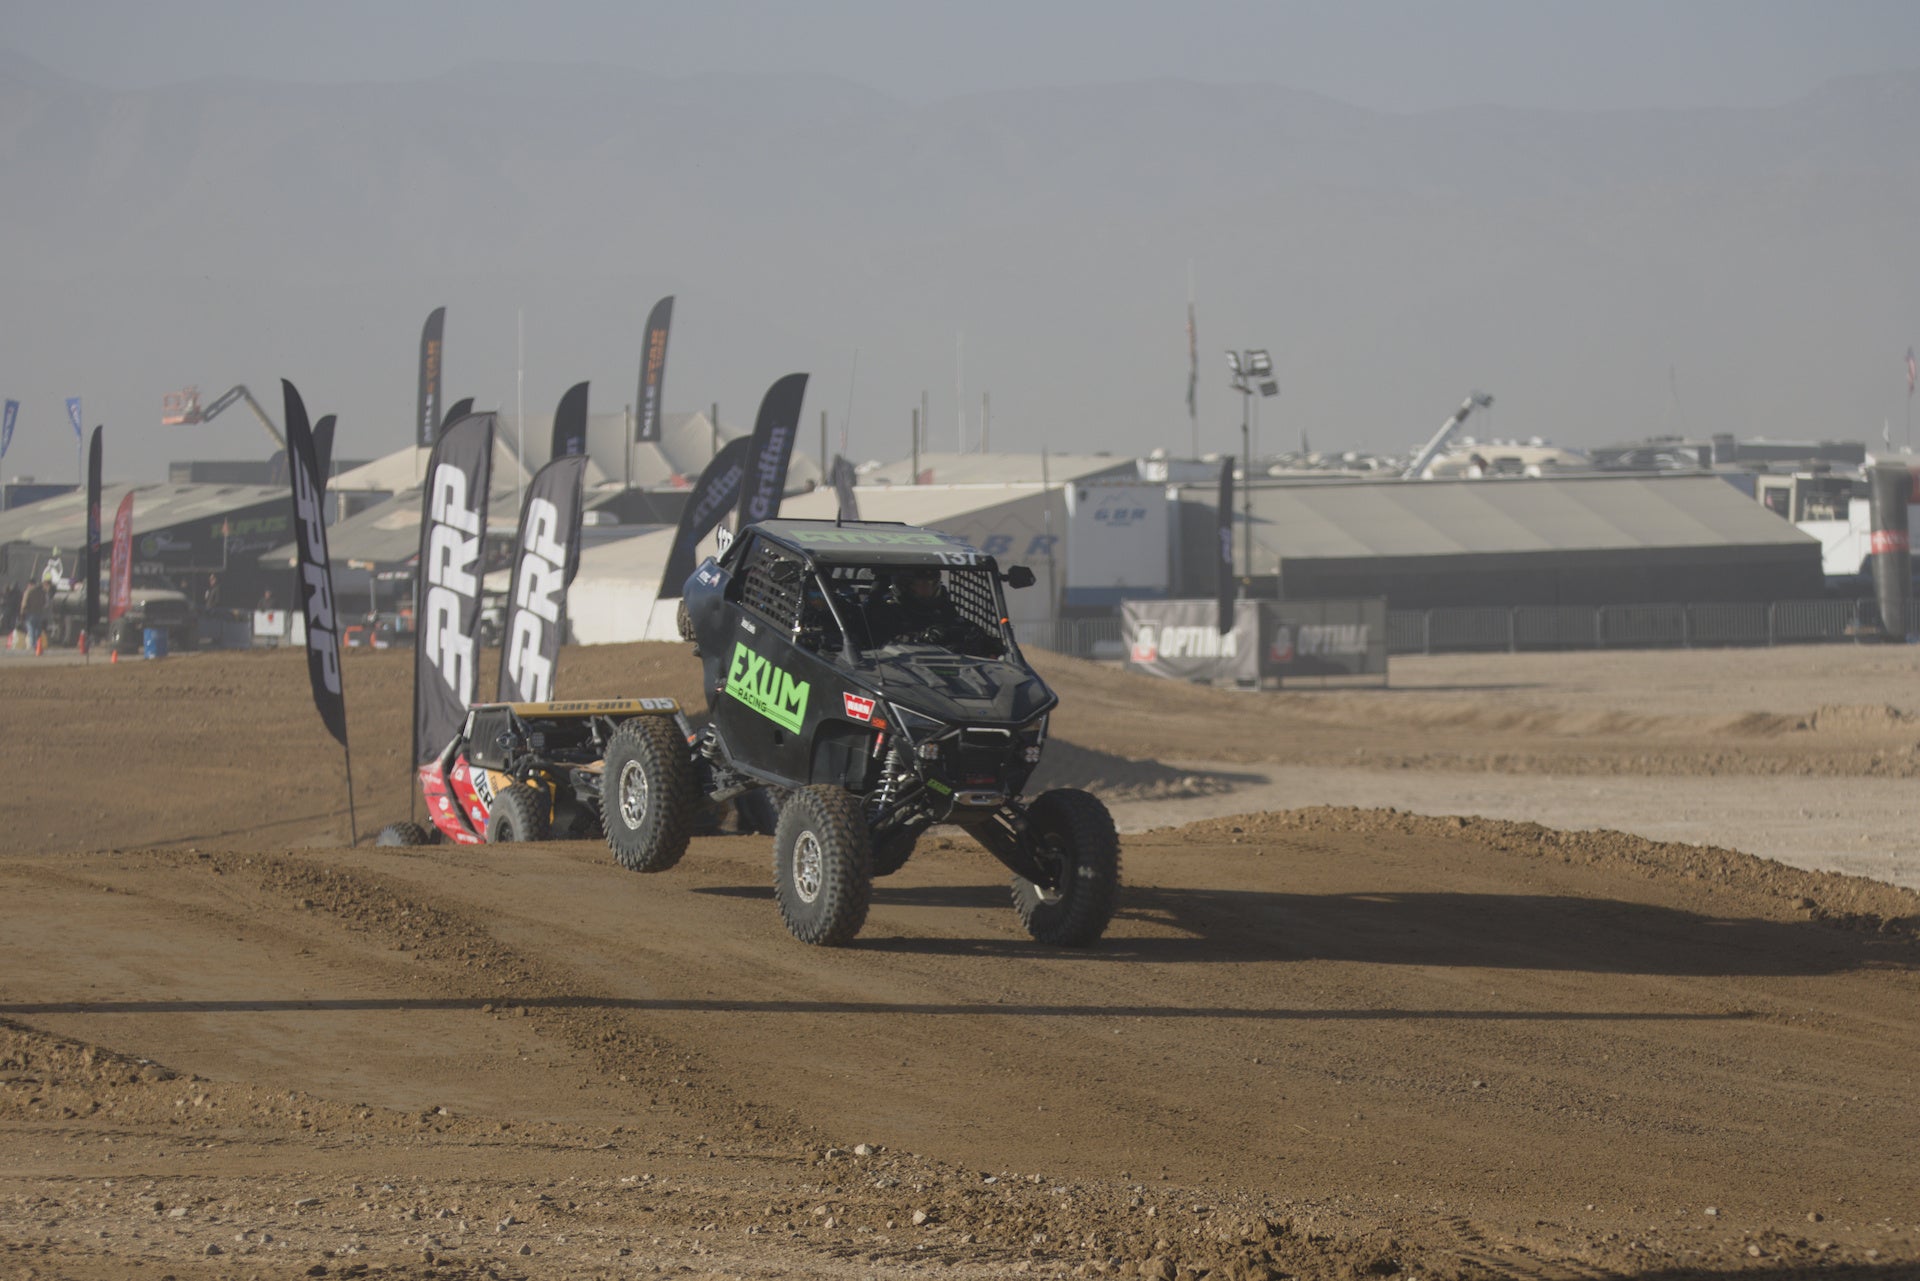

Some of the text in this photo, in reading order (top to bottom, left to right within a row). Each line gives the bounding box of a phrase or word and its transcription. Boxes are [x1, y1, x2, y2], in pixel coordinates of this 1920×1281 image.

[292, 445, 341, 695] PRP
[426, 463, 480, 710] PRP
[509, 498, 566, 702] PRP
[1298, 625, 1370, 656] OPTIMA
[727, 641, 810, 720] EXUM
[737, 688, 767, 712] RACING
